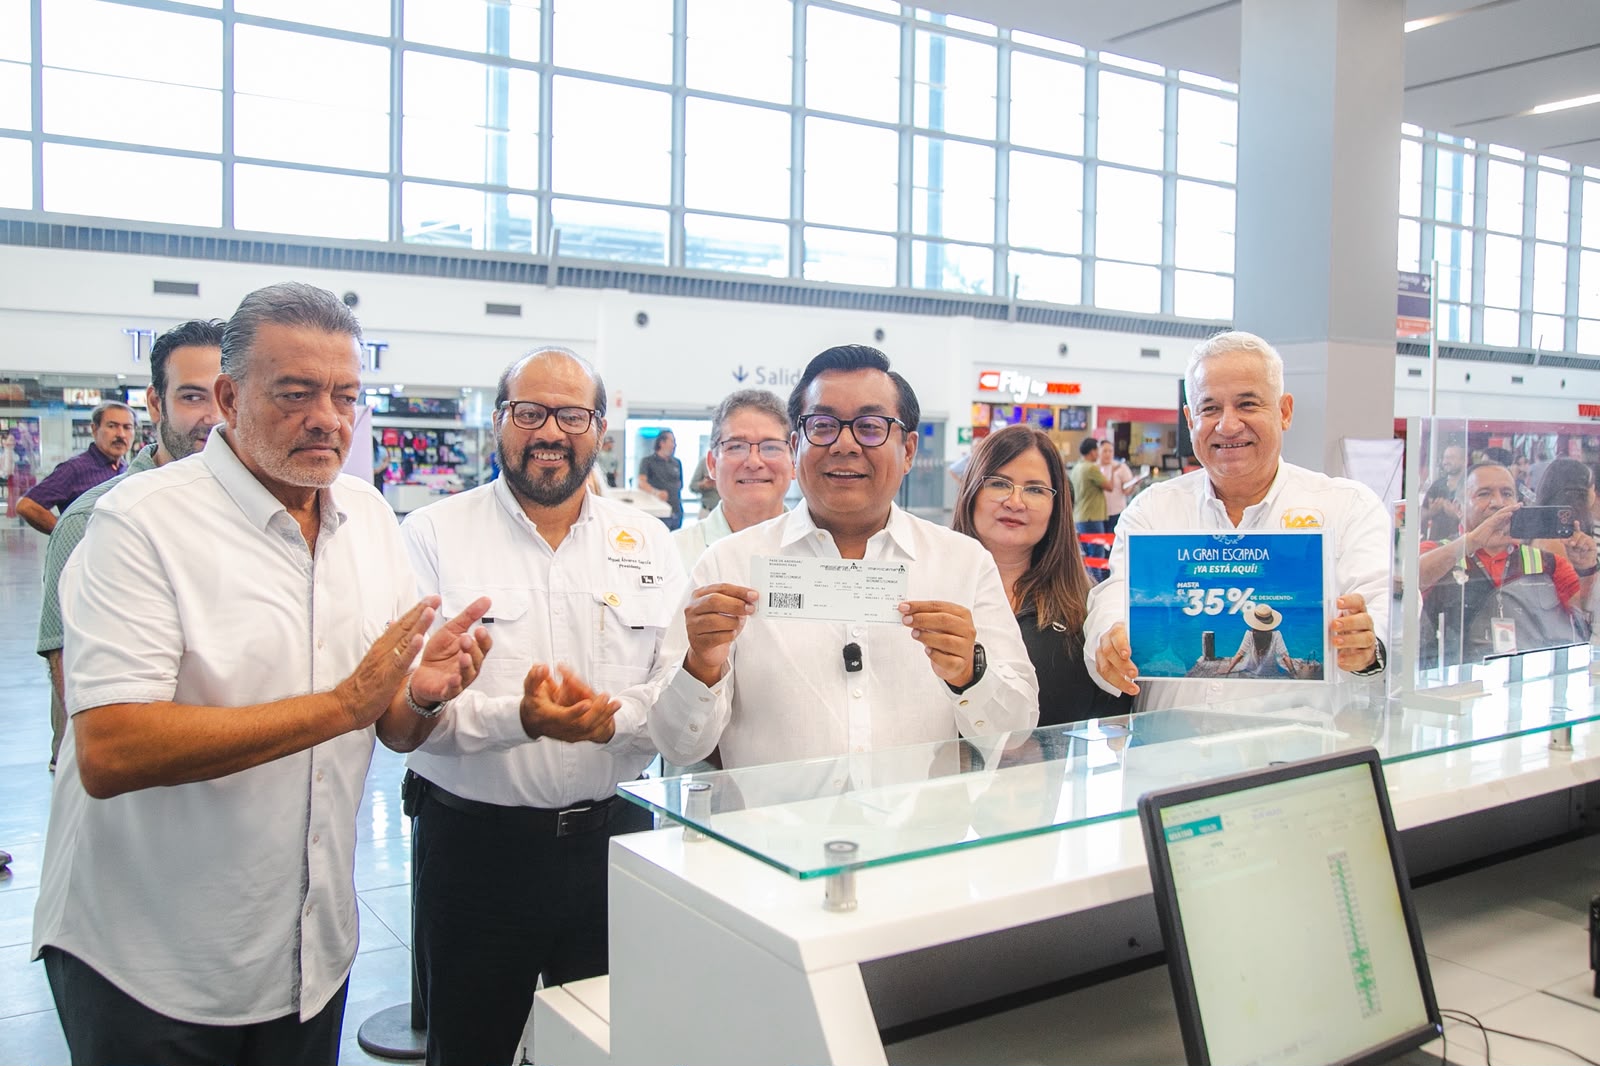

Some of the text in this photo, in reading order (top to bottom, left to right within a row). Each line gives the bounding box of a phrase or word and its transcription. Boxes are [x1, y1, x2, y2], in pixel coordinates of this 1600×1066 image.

[1177, 548, 1270, 561] LA GRAN ESCAPADA
[1193, 563, 1258, 575] ¡YA ESTÁ AQUÍ!
[1182, 587, 1256, 616] 35%
